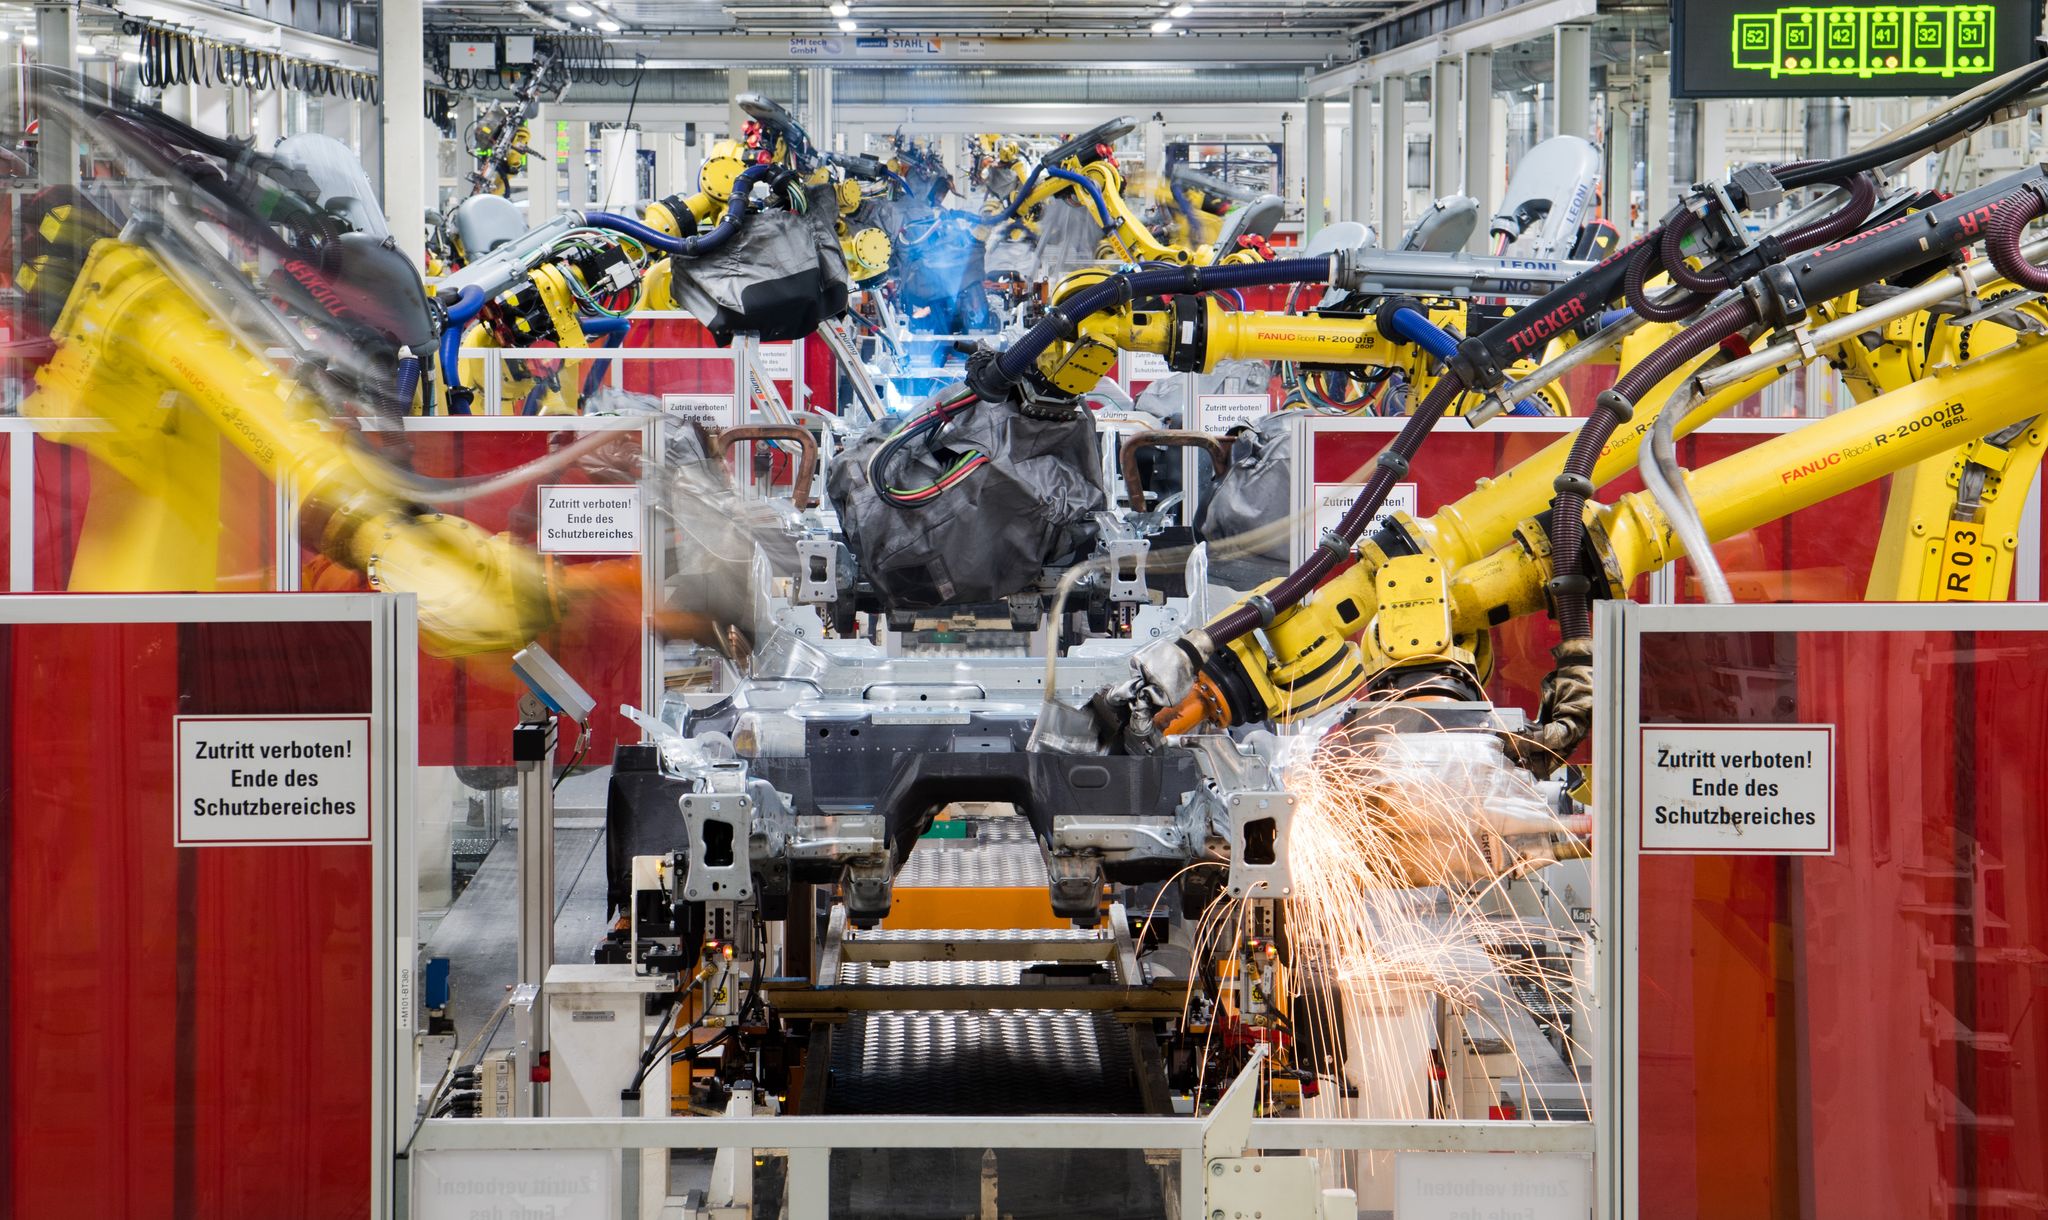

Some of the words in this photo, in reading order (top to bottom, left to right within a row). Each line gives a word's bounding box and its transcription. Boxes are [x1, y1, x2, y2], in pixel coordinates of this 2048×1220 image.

[1746, 29, 1764, 44] 52
[1789, 29, 1805, 43] 51
[1832, 29, 1850, 43] 42
[1875, 29, 1891, 43] 41
[1919, 28, 1936, 42] 32
[1962, 28, 1978, 42] 31
[893, 39, 923, 48] STAHL
[1566, 183, 1589, 225] LEONI
[1258, 332, 1296, 341] FANUC
[1317, 334, 1375, 344] R-2000iB
[1205, 404, 1227, 412] Zutritt
[1228, 404, 1262, 412] verboten!
[702, 413, 715, 421] des
[1217, 414, 1236, 422] Ende
[1941, 415, 1969, 429] 185L
[1781, 452, 1841, 485] FANUC
[1843, 441, 1873, 460] Robot
[1874, 402, 1965, 447] R-2000iB
[548, 498, 580, 509] Zutritt
[582, 498, 632, 509] verboten!
[1322, 496, 1353, 507] Zutritt
[567, 513, 593, 524] Ende
[595, 513, 614, 524] des
[547, 528, 634, 539] Schutzbereiches
[195, 741, 255, 760] Zutritt
[260, 740, 352, 759] verboten!
[1657, 750, 1716, 768] Zutritt
[1720, 750, 1812, 768] verboten!
[231, 769, 278, 787] Ende
[284, 769, 319, 787] des
[1692, 778, 1739, 796] Ende
[1745, 778, 1779, 796] des
[193, 797, 356, 816] Schutzbereiches
[1655, 806, 1816, 825] Schutzbereiches
